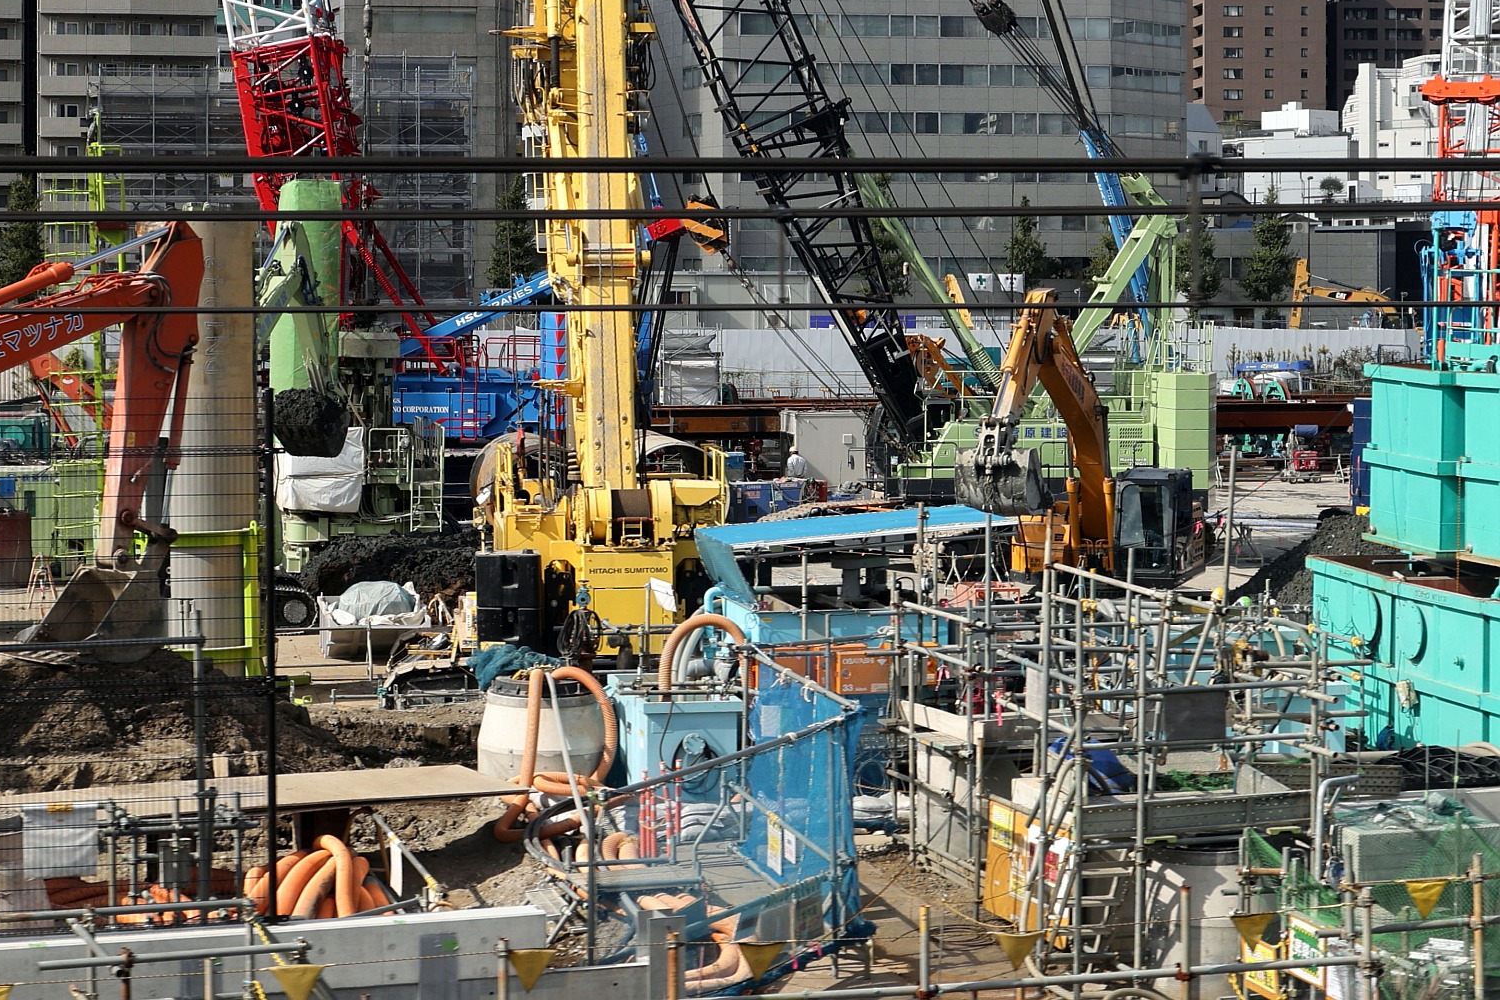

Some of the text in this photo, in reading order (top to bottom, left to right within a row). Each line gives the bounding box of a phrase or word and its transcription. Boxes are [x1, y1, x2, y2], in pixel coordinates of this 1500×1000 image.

[486, 286, 533, 307] RANES
[1335, 292, 1347, 300] CAT
[403, 406, 449, 414] CORPORATION
[842, 684, 853, 692] 33
